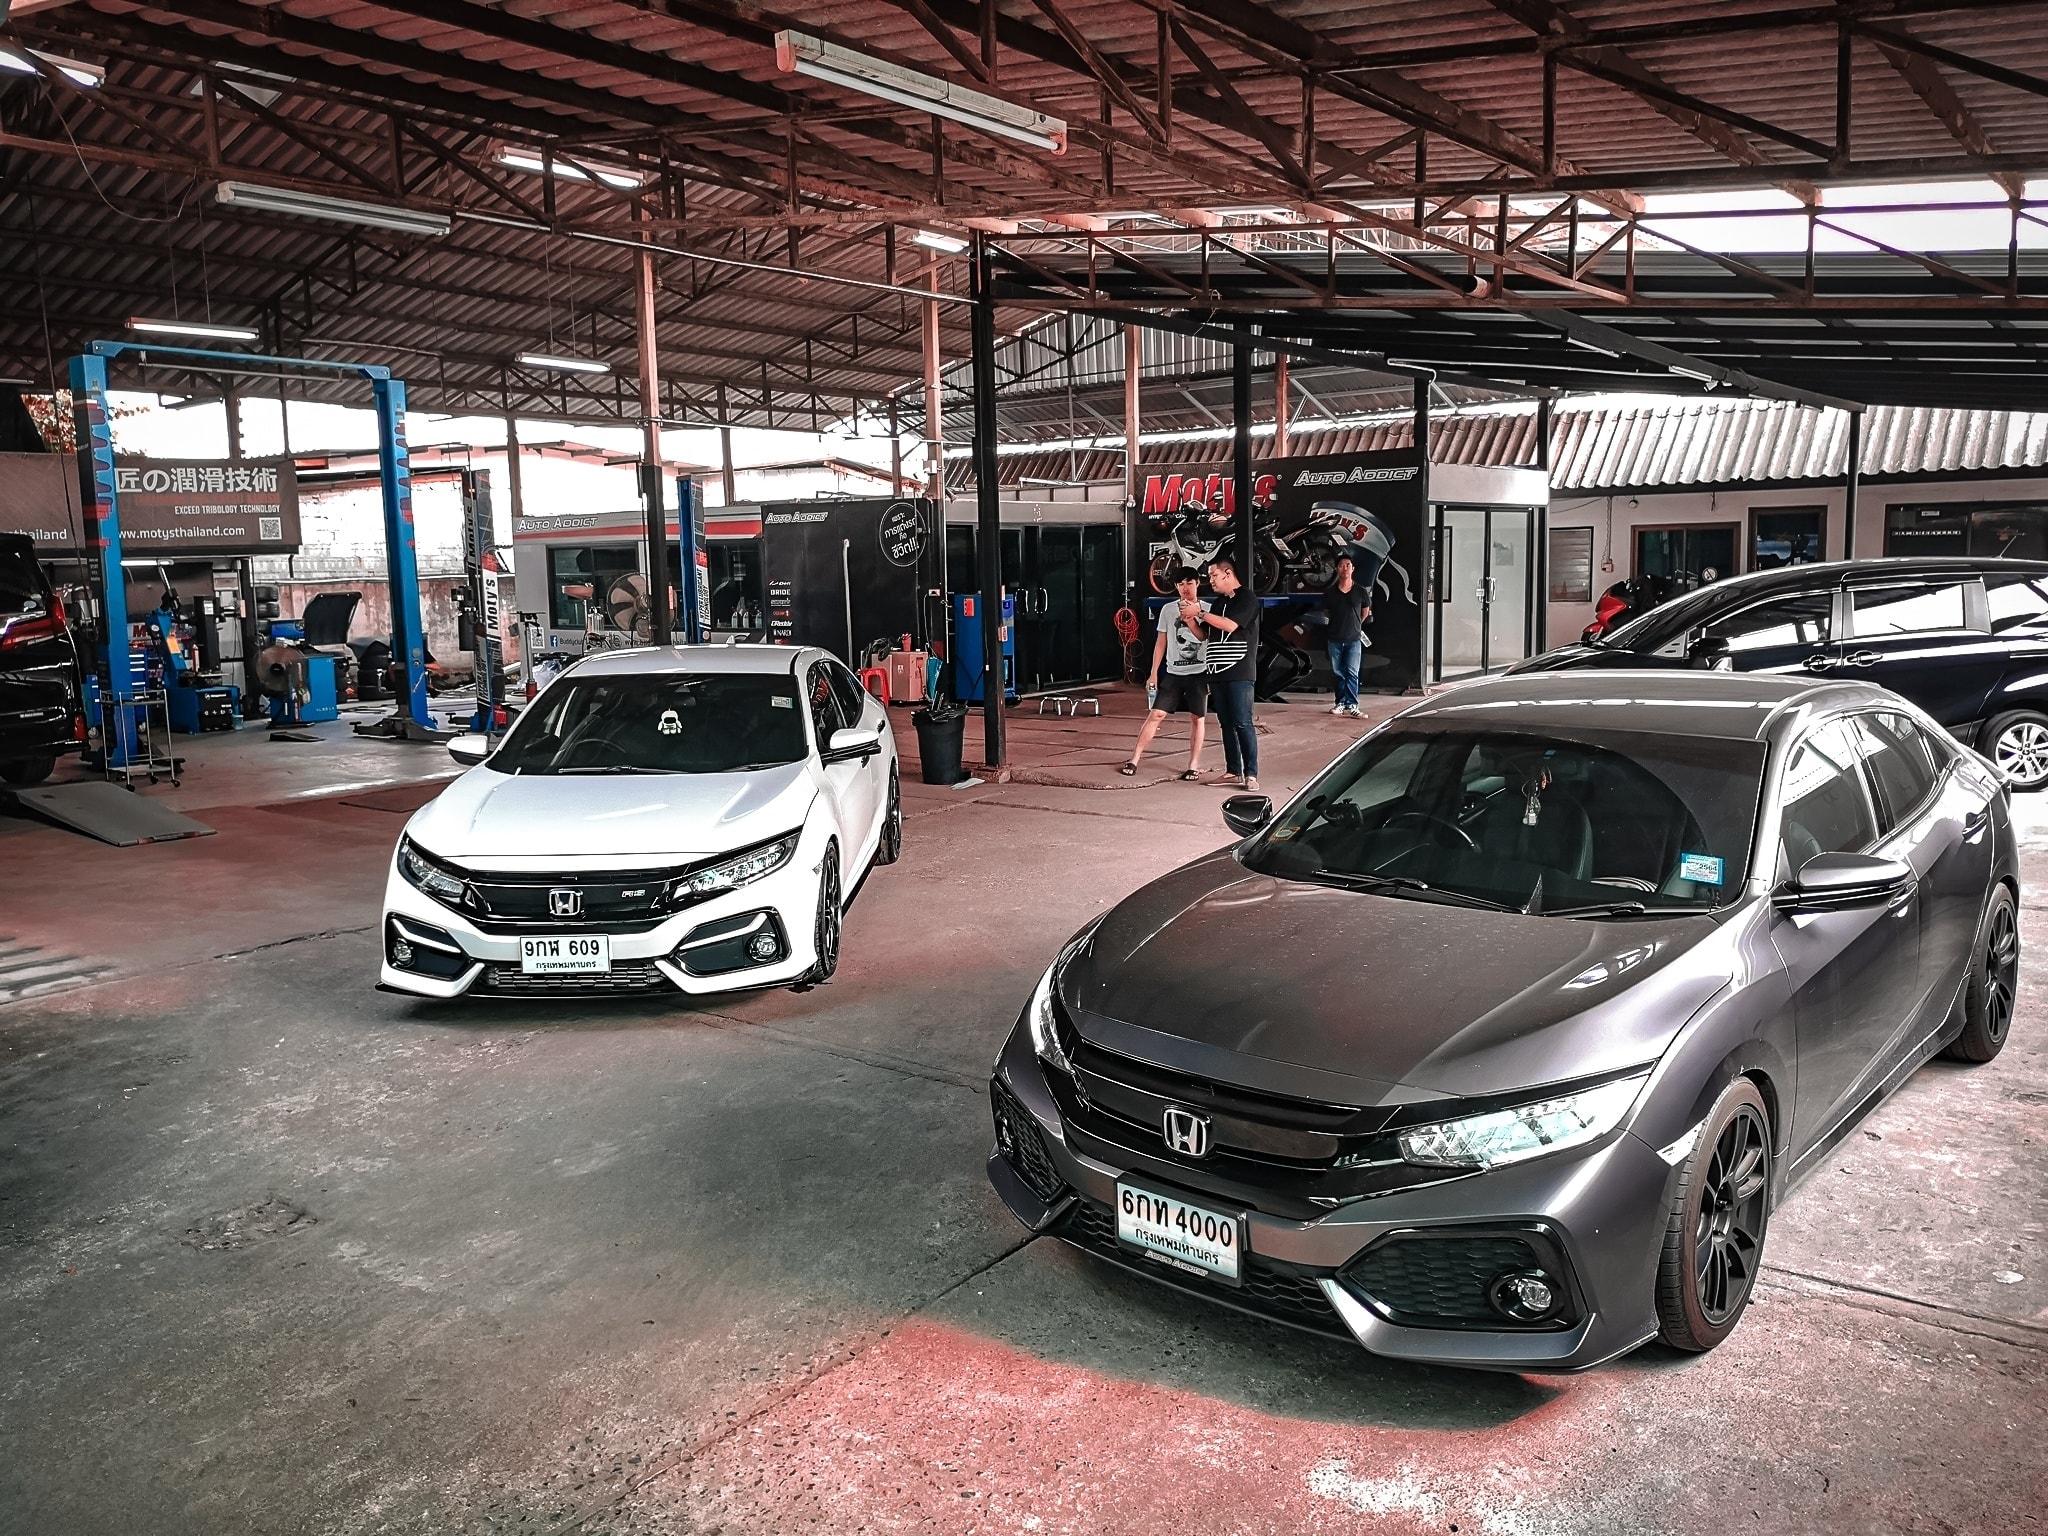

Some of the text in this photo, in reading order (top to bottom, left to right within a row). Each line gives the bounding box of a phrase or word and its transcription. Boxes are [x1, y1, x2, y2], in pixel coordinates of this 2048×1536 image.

[114, 467, 278, 493] 匠の潤滑技術
[1345, 466, 1419, 484] ADDICT
[174, 503, 280, 515] EXCEED TRIBOLOGY TECHNOLOGY
[552, 517, 598, 530] ADDICT
[119, 526, 245, 541] ww.motysthailand.com
[485, 578, 499, 632] Moty's
[569, 940, 600, 956] 609
[535, 961, 597, 972] กรุงเทพมหานคร
[1122, 1189, 1232, 1248] 6กท 4000
[1135, 1227, 1219, 1266] กรุงเทพมหานคร
